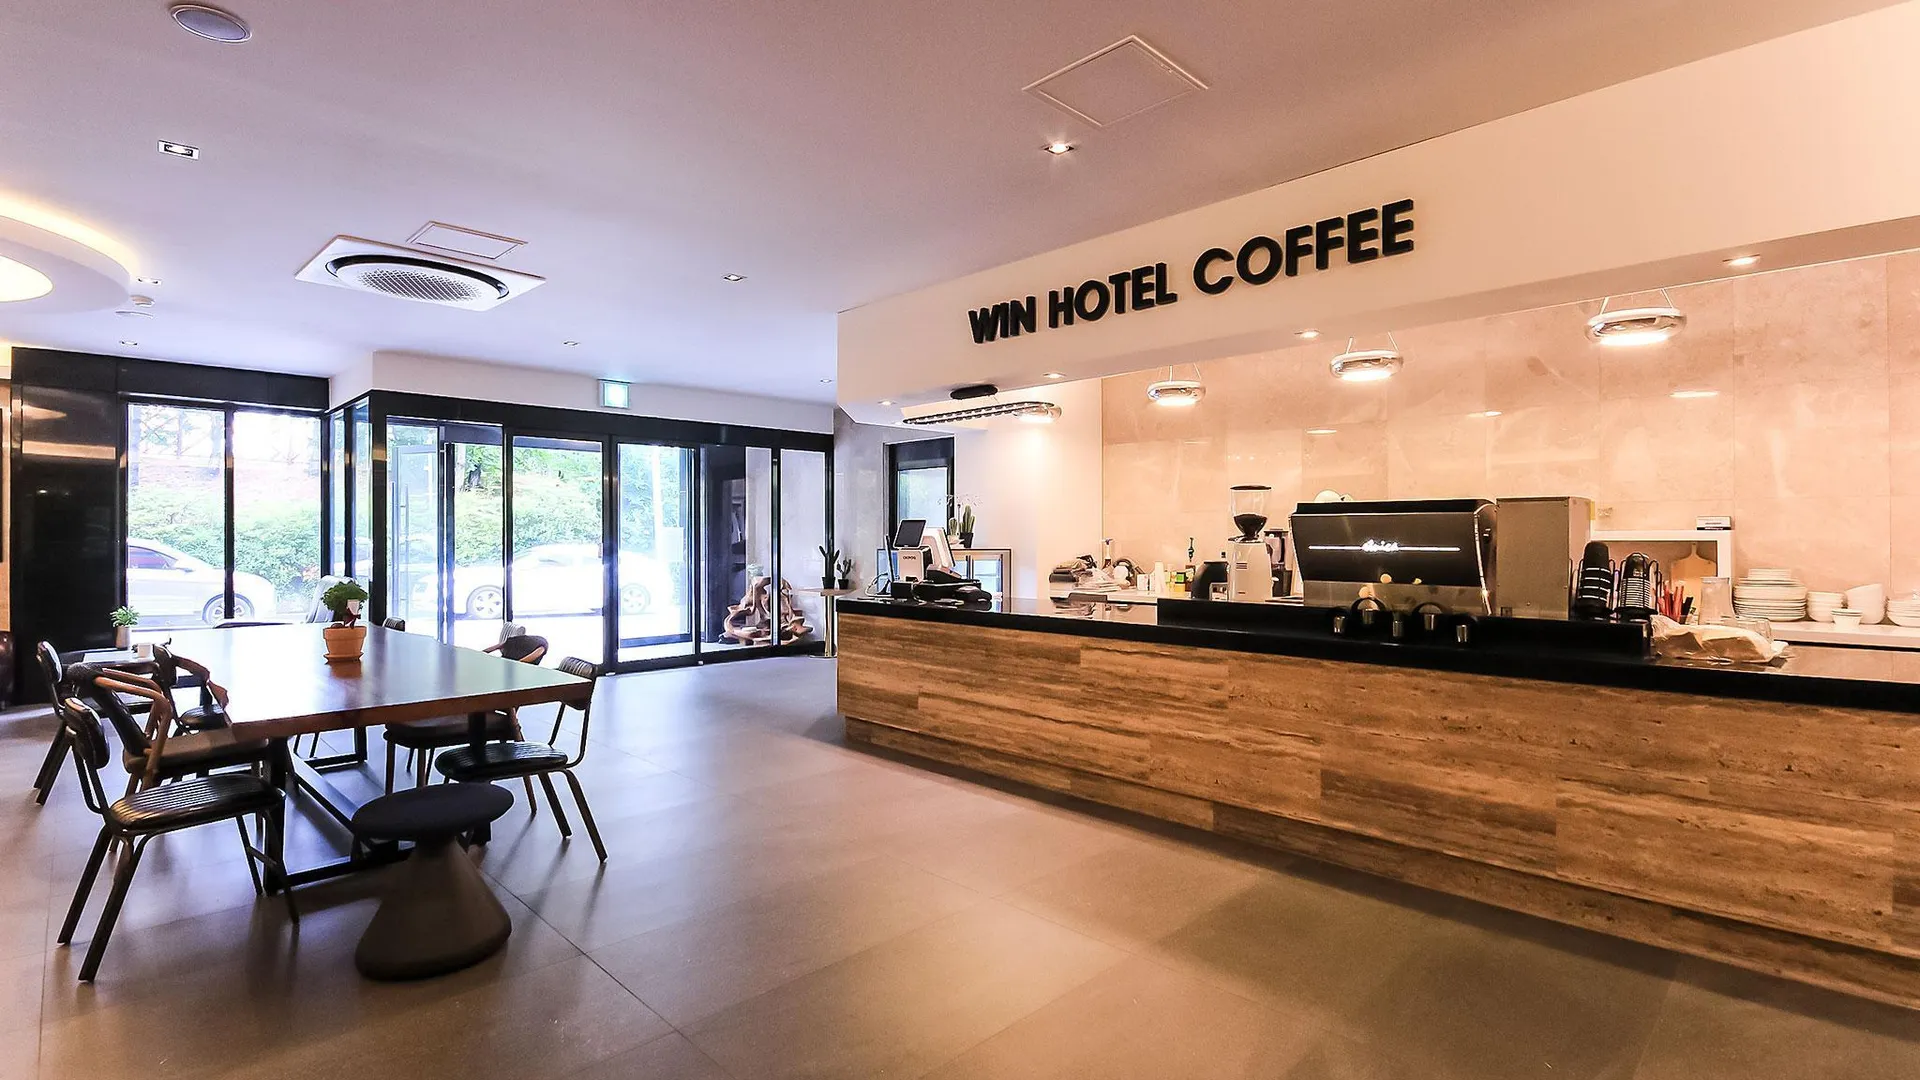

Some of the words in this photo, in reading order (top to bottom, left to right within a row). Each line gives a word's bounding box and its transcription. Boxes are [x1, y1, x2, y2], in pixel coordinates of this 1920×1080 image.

[968, 296, 1037, 344] WIN
[1048, 262, 1178, 329] HOTEL
[1193, 198, 1415, 295] COFFEE
